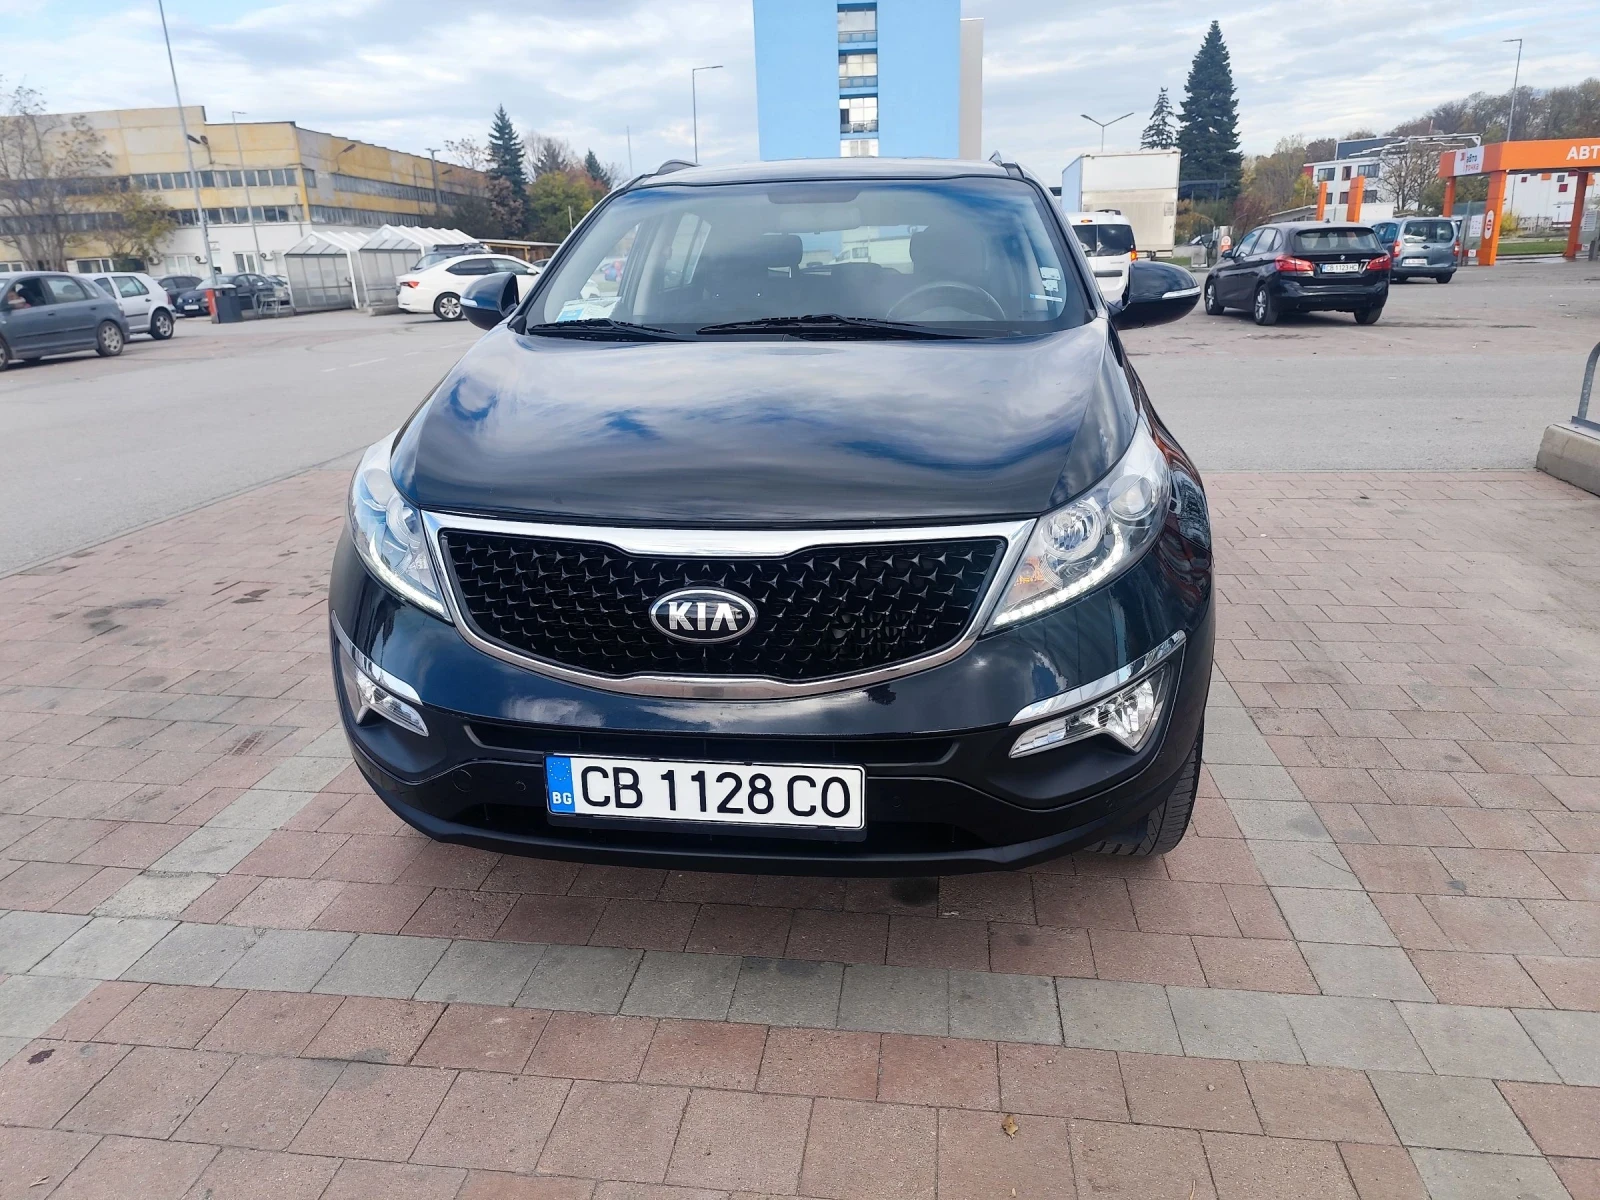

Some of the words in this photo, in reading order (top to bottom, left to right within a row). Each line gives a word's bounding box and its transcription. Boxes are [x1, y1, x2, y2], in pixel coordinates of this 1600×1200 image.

[668, 601, 738, 631] KIA
[552, 791, 573, 805] BG
[581, 765, 643, 809] CB
[660, 769, 775, 815] 1128
[787, 774, 851, 819] CO
